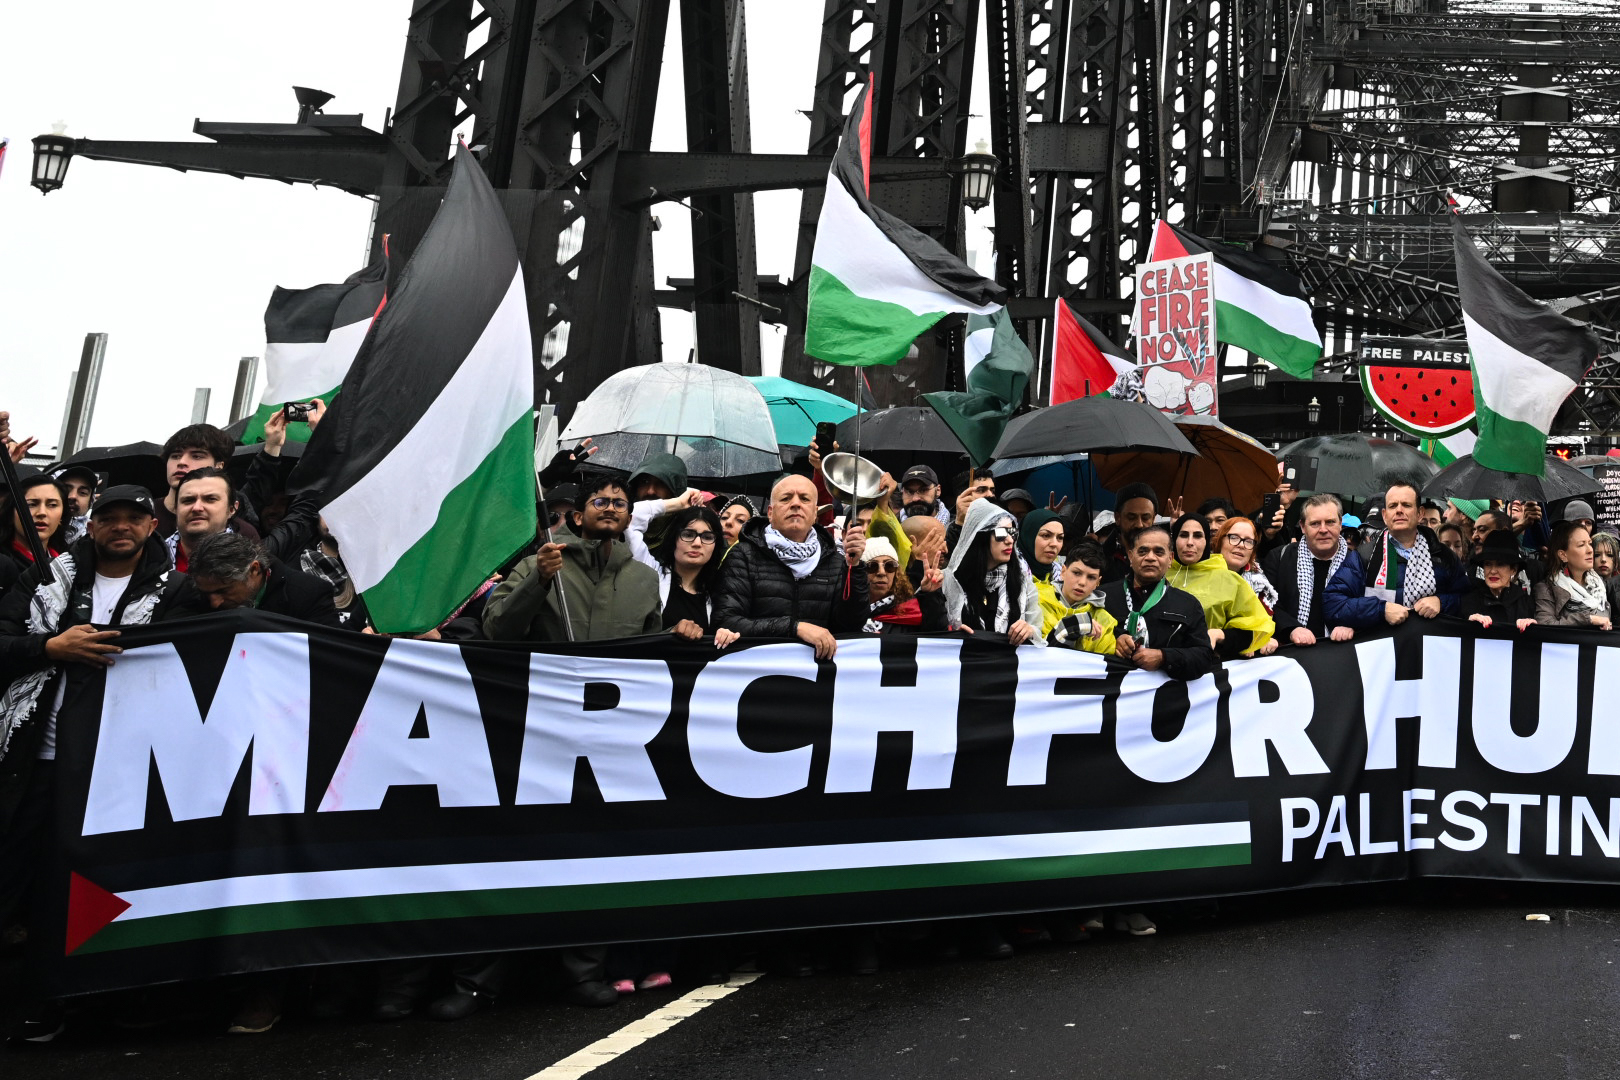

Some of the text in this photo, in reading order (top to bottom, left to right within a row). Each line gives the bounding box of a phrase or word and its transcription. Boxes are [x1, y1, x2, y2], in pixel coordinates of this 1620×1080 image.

[1140, 261, 1209, 297] CEASE
[1141, 288, 1209, 336] FIRE
[1362, 347, 1470, 364] FREE PALEST
[81, 631, 964, 836] MARCH
[1007, 645, 1332, 786] FOR
